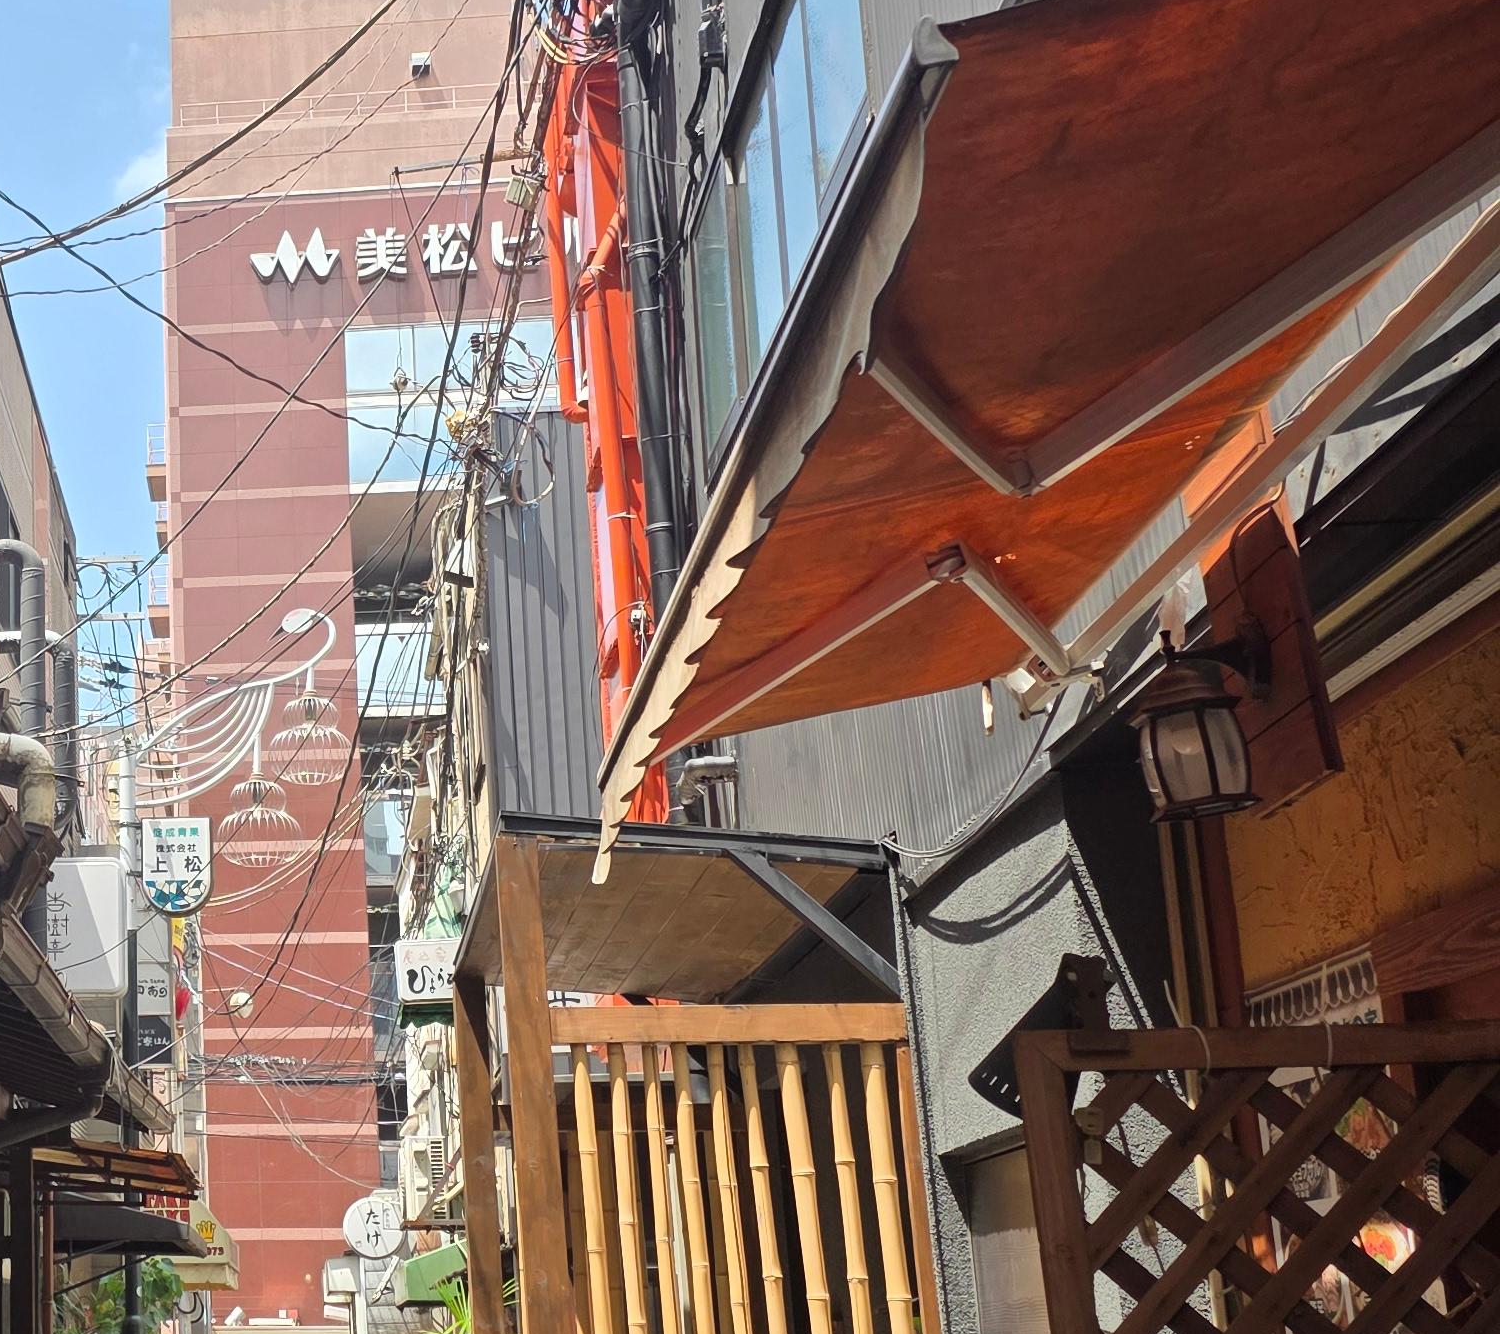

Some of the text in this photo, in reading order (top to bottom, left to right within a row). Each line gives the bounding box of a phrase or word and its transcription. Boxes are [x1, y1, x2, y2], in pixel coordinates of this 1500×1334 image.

[156, 843, 197, 853] 株式会社
[365, 1208, 381, 1248] たけ
